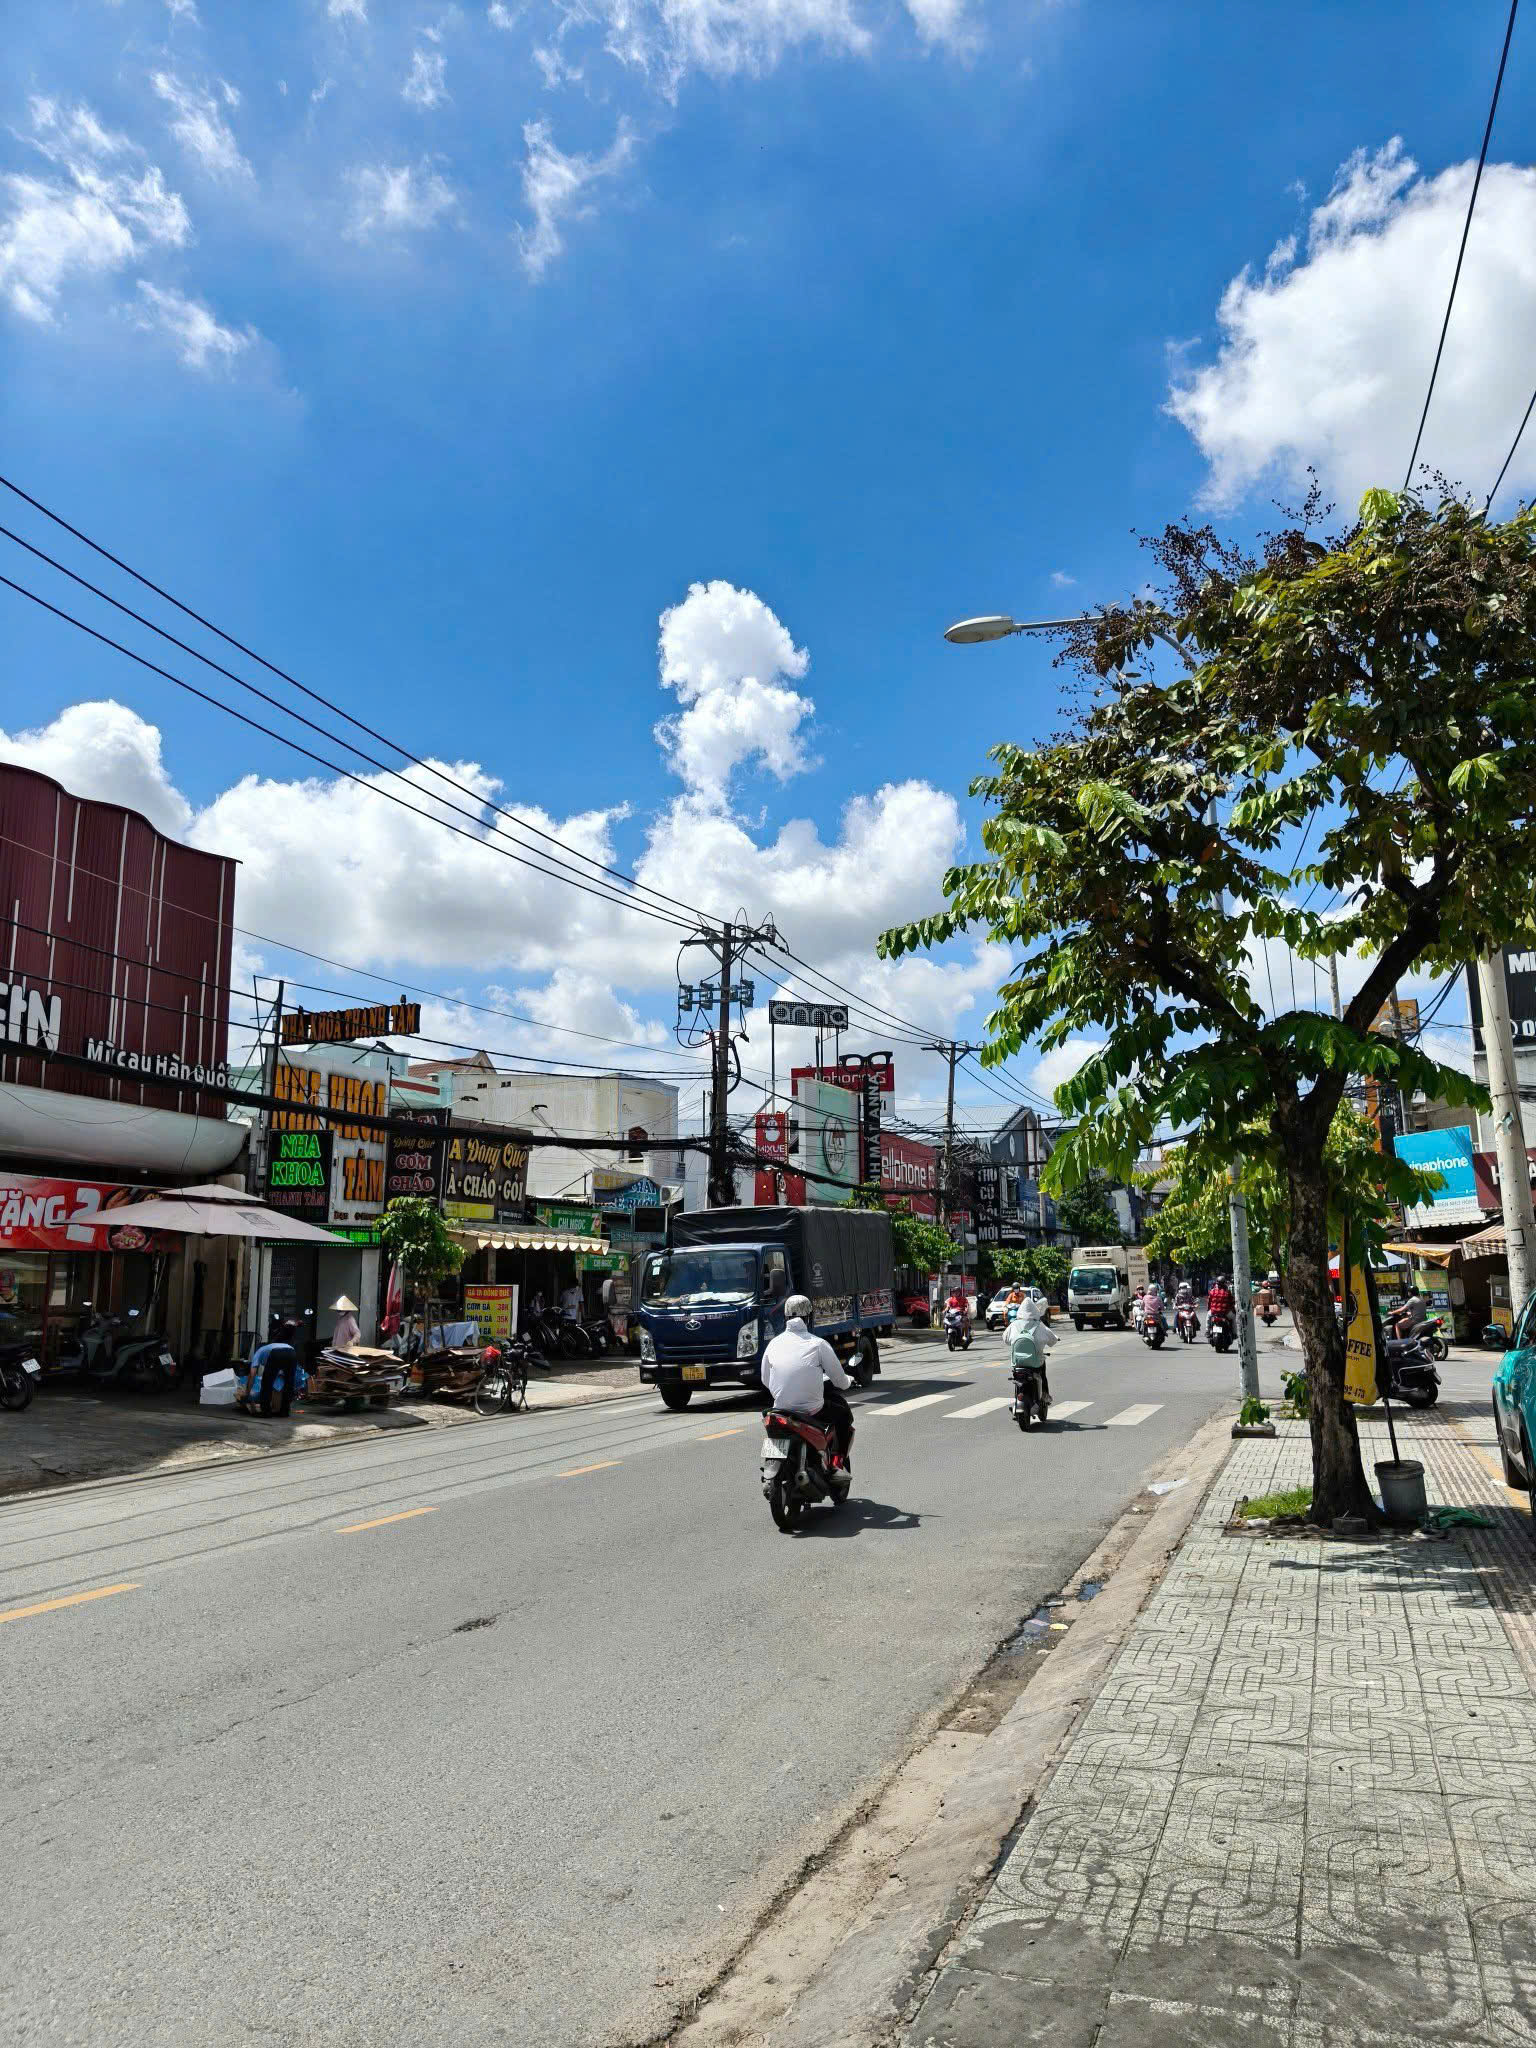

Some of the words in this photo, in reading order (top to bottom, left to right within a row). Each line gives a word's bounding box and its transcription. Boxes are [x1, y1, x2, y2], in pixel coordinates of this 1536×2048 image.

[156, 1053, 191, 1081] Hàn
[280, 1134, 322, 1159] NHA
[757, 1144, 785, 1153] MIXUE
[271, 1161, 325, 1186] KHOA
[389, 1172, 435, 1192] CHÁO
[463, 1171, 497, 1199] CHÁO
[503, 1173, 524, 1202] GỎI
[0, 1189, 66, 1235] ẶNG
[978, 1222, 999, 1241] MỚI
[1345, 1338, 1373, 1358] FFEE
